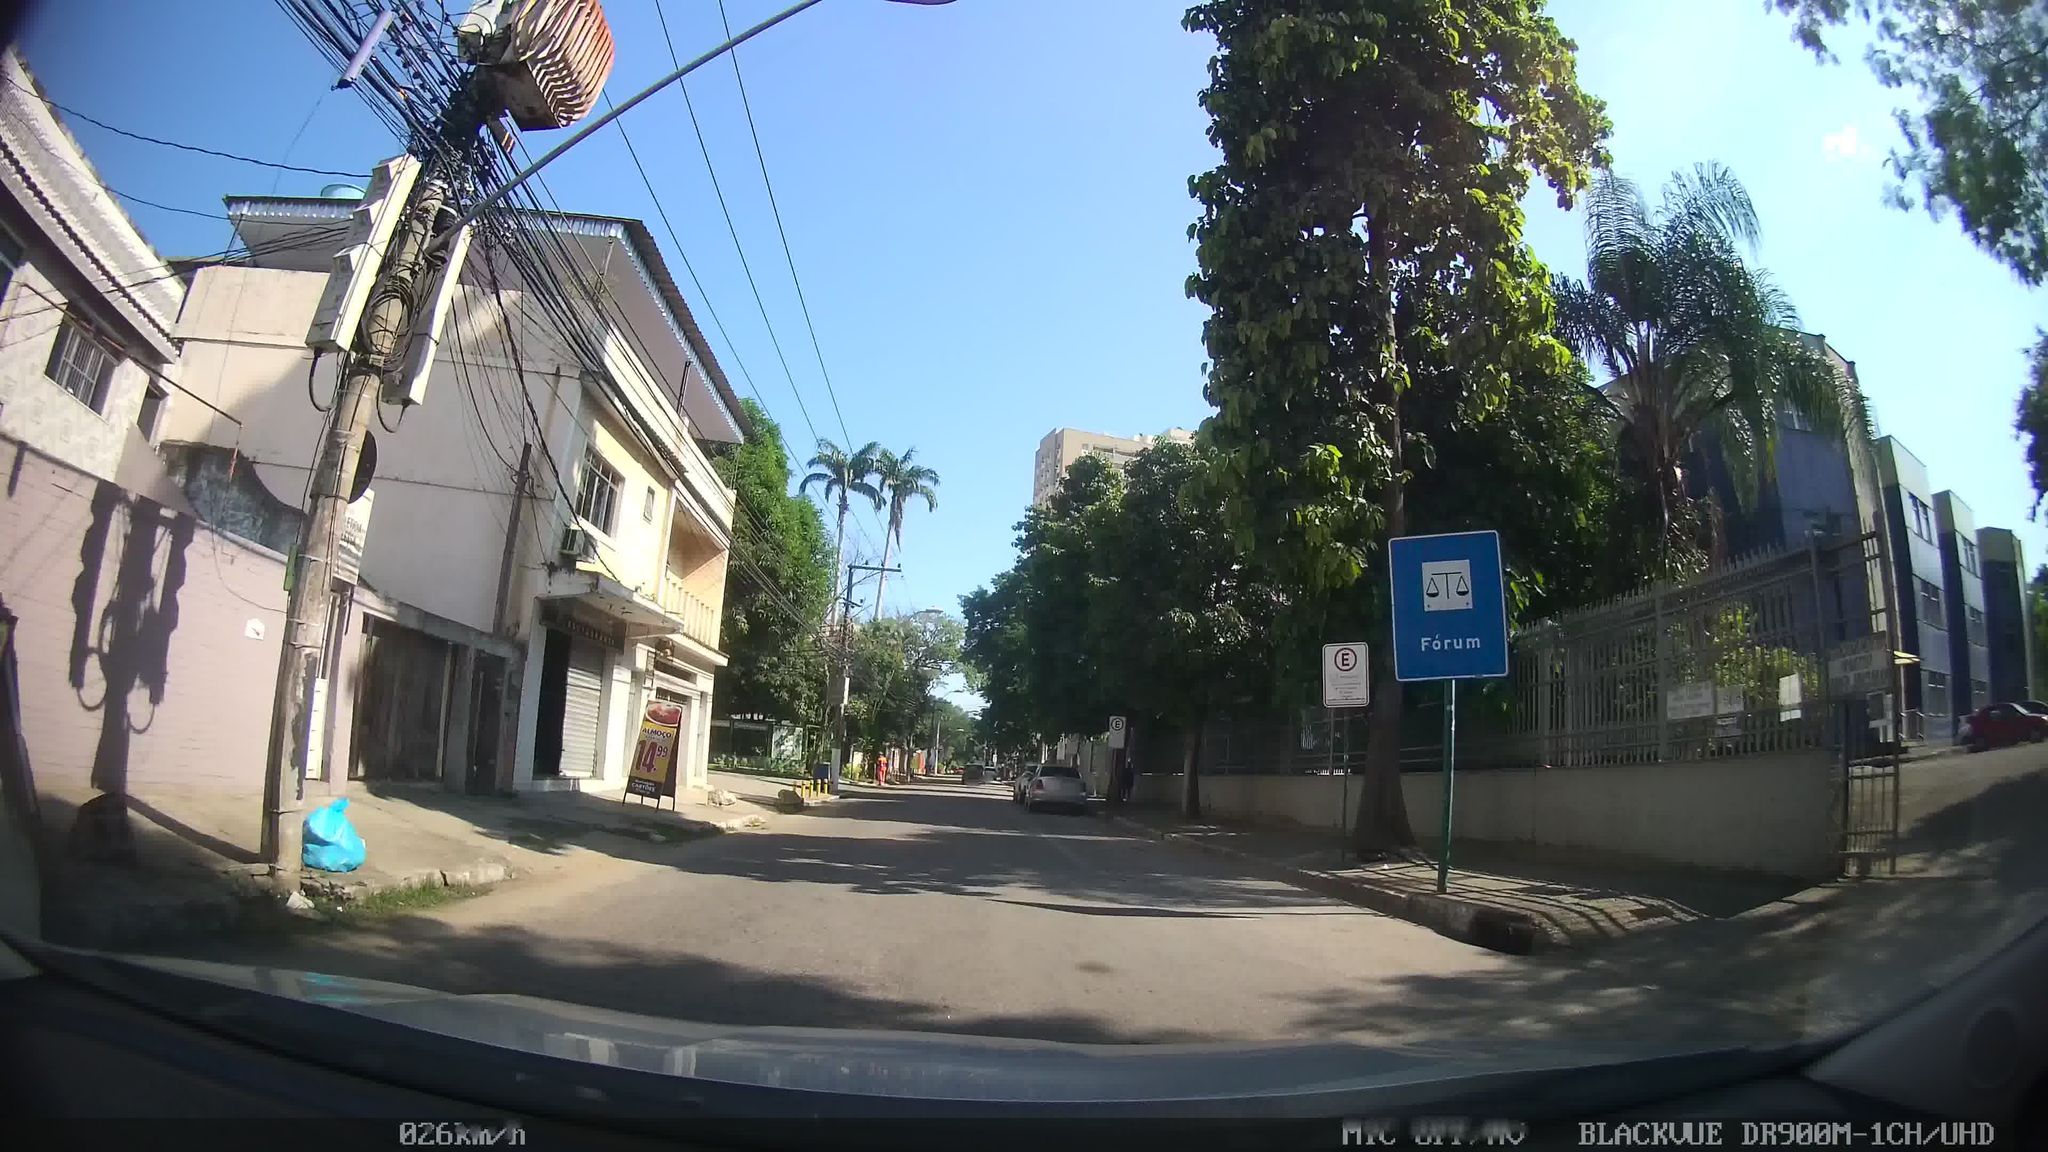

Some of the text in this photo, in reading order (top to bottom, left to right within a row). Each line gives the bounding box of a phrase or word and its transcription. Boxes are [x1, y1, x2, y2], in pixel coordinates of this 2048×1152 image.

[1421, 633, 1481, 652] Fórum
[1341, 652, 1350, 667] E
[642, 728, 672, 739] ALMOÇO
